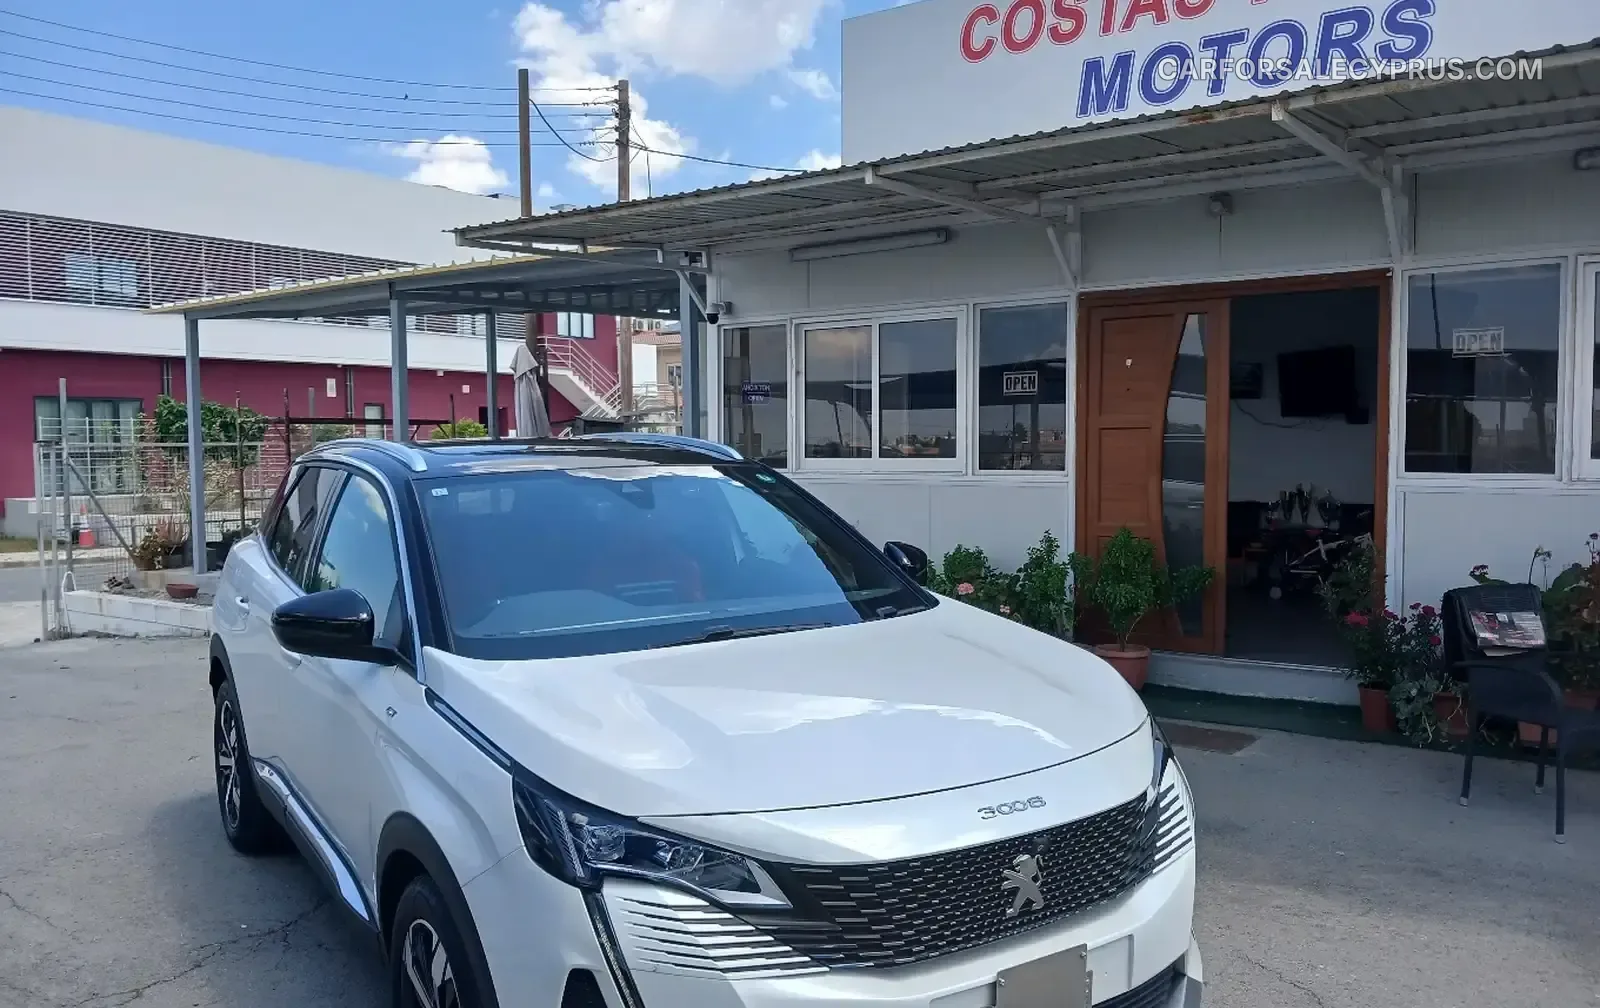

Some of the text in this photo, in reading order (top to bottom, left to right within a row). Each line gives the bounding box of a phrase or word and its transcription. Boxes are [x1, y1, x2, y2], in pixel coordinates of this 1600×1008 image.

[1076, 0, 1436, 118] MOTORS
[1456, 332, 1501, 351] OPEN
[1006, 375, 1036, 391] OPEN
